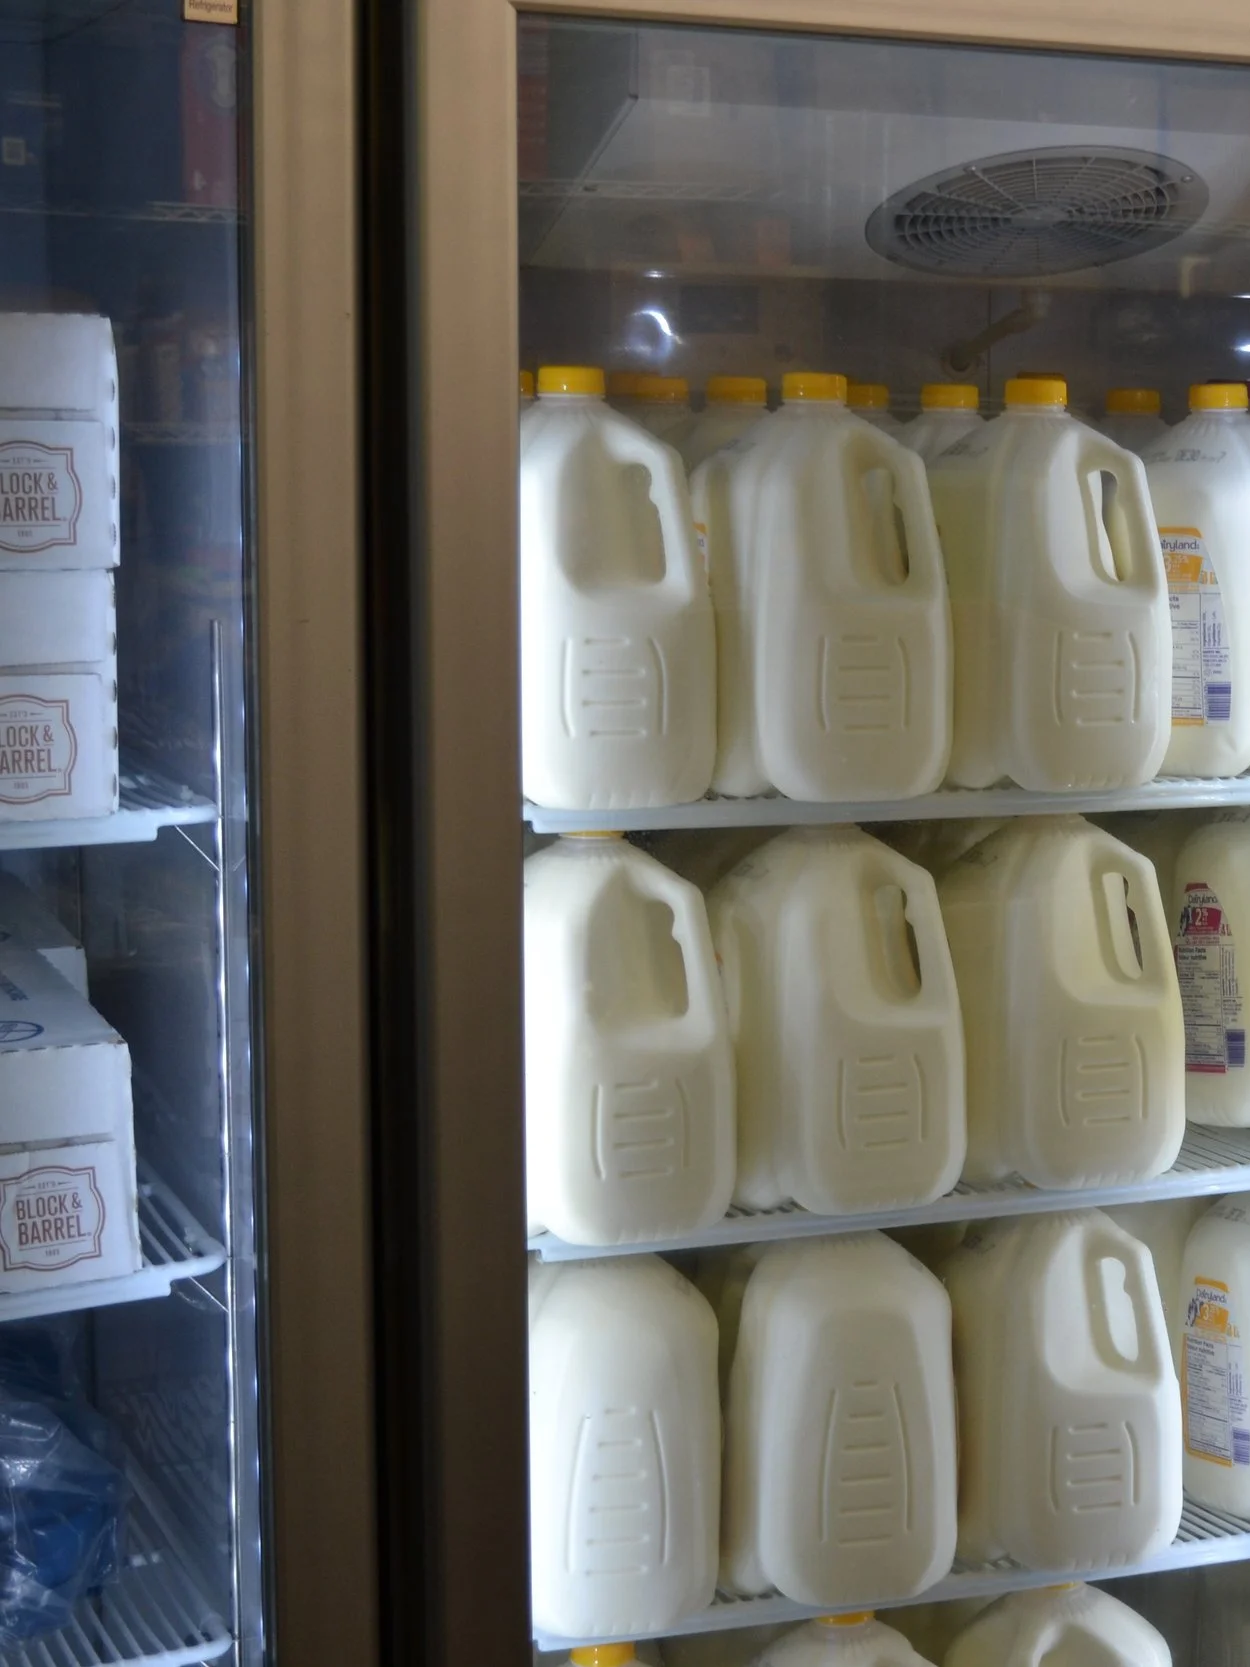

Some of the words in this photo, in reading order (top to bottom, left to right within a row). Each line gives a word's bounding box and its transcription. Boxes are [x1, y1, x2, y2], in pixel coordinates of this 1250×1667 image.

[0, 472, 44, 495] LOCK
[47, 472, 58, 491] &
[0, 496, 62, 522] ARREL
[0, 725, 40, 748] LOCK
[43, 724, 54, 742] &
[0, 748, 57, 774] ARREL
[16, 1193, 69, 1220] BLOCK
[71, 1191, 83, 1209] &
[18, 1214, 86, 1246] BARREL
